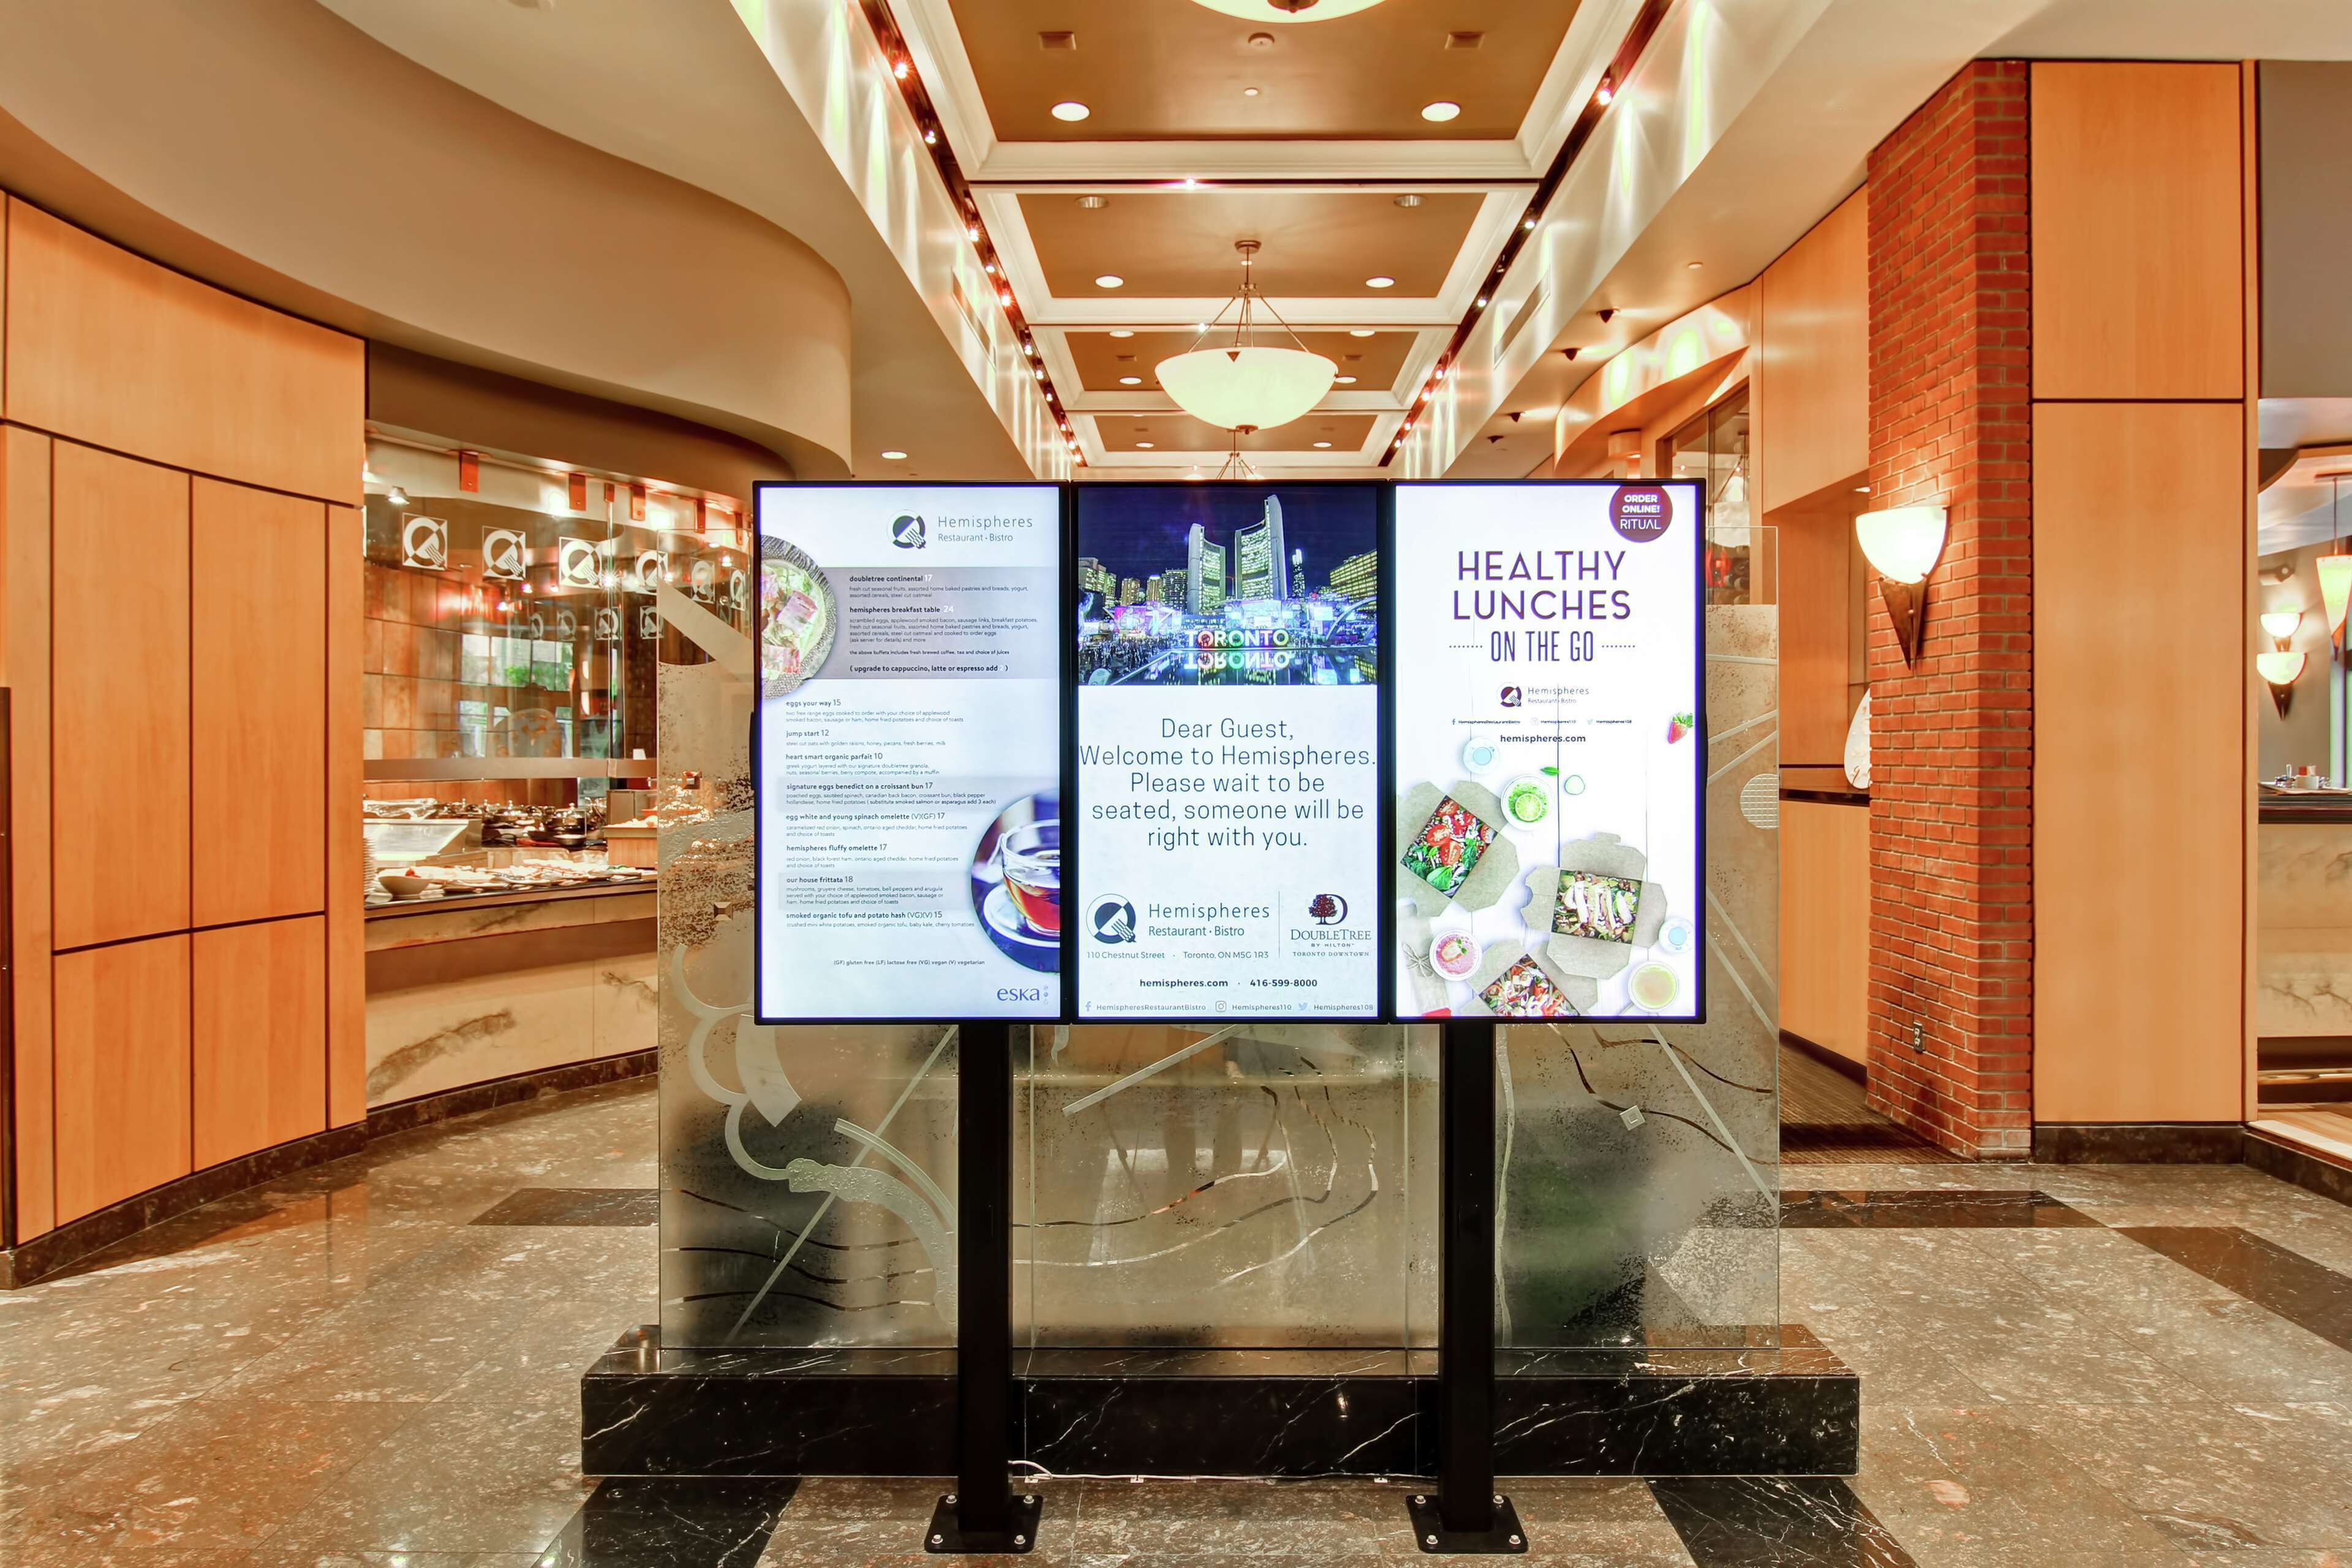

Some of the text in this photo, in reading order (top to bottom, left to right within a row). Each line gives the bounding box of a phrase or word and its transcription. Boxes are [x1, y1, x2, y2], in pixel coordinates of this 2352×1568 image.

[1624, 494, 1658, 503] ORDER
[1622, 505, 1660, 513] ONLINE!
[938, 516, 1032, 530] Hemispheres
[1621, 519, 1661, 529] RITUAL
[1459, 551, 1626, 580] HEALTHY
[1455, 590, 1630, 619] LUNCHES
[1183, 630, 1289, 648] TORONTO
[1491, 631, 1593, 662] ON THE GO
[1528, 685, 1589, 696] Hemispheres
[1163, 718, 1292, 740] Dear Guest,
[1500, 734, 1586, 743] hemispheres.com
[1080, 745, 1376, 769] Welcome to Hemispheres.
[1132, 772, 1324, 792] Please wait to be
[1093, 799, 1363, 821] seated, someone will be
[1149, 826, 1306, 851] right with you.
[829, 844, 848, 853] fluffy
[1150, 903, 1269, 921] Hemispheres
[1149, 926, 1244, 936] Restaurant Bistro
[1140, 979, 1228, 988] hemispheres.com
[997, 989, 1039, 1001] eska
